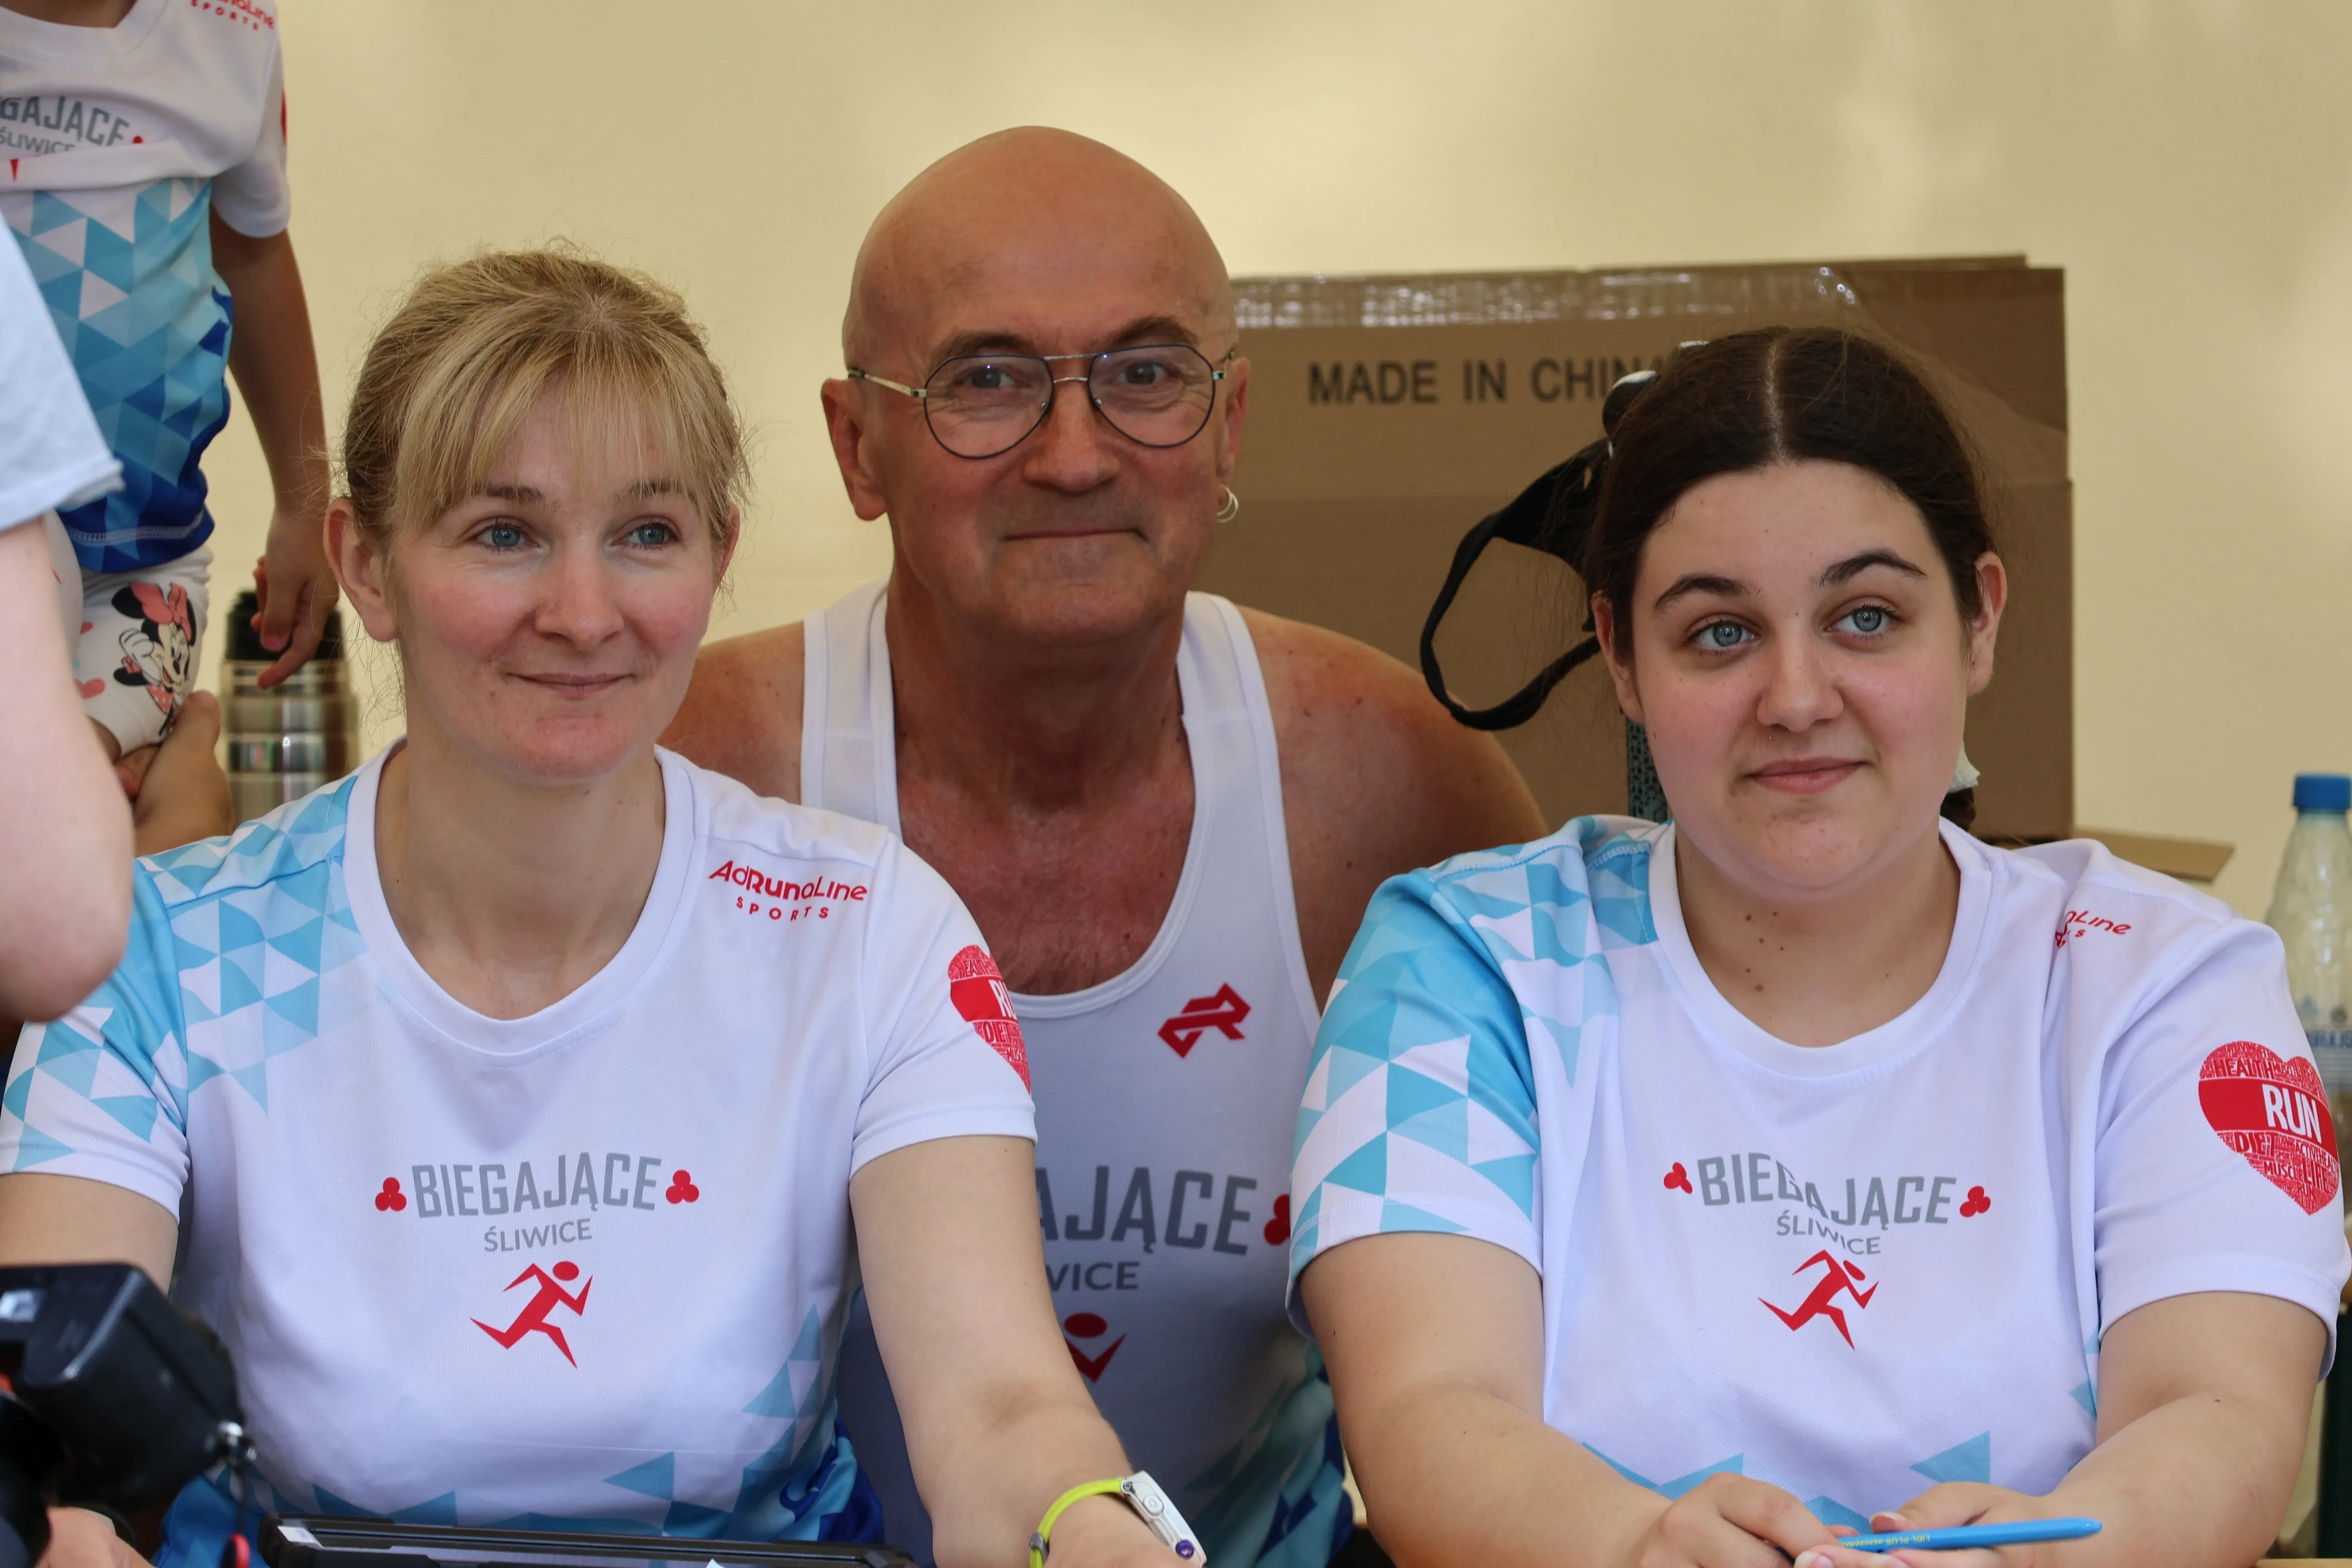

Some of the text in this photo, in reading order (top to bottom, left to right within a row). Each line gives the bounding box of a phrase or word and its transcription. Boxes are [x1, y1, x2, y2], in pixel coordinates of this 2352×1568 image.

[1308, 360, 1439, 405] MADE
[1463, 358, 1508, 404] IN
[736, 896, 829, 921] SPORTS
[2212, 1058, 2276, 1081] HEALTH
[2262, 1083, 2322, 1144] RUN
[2234, 1131, 2276, 1157] DIET
[412, 1152, 662, 1218] BIEGAJĄCE
[1697, 1152, 1957, 1230] BIEGAJĄCE
[1035, 1165, 1258, 1256] AJĄCE
[484, 1218, 592, 1252] ŚLIWICE
[1776, 1209, 1881, 1255] ŚLIWICE
[1886, 1535, 1909, 1546] PLUS
[1911, 1533, 1931, 1544] LIDL
